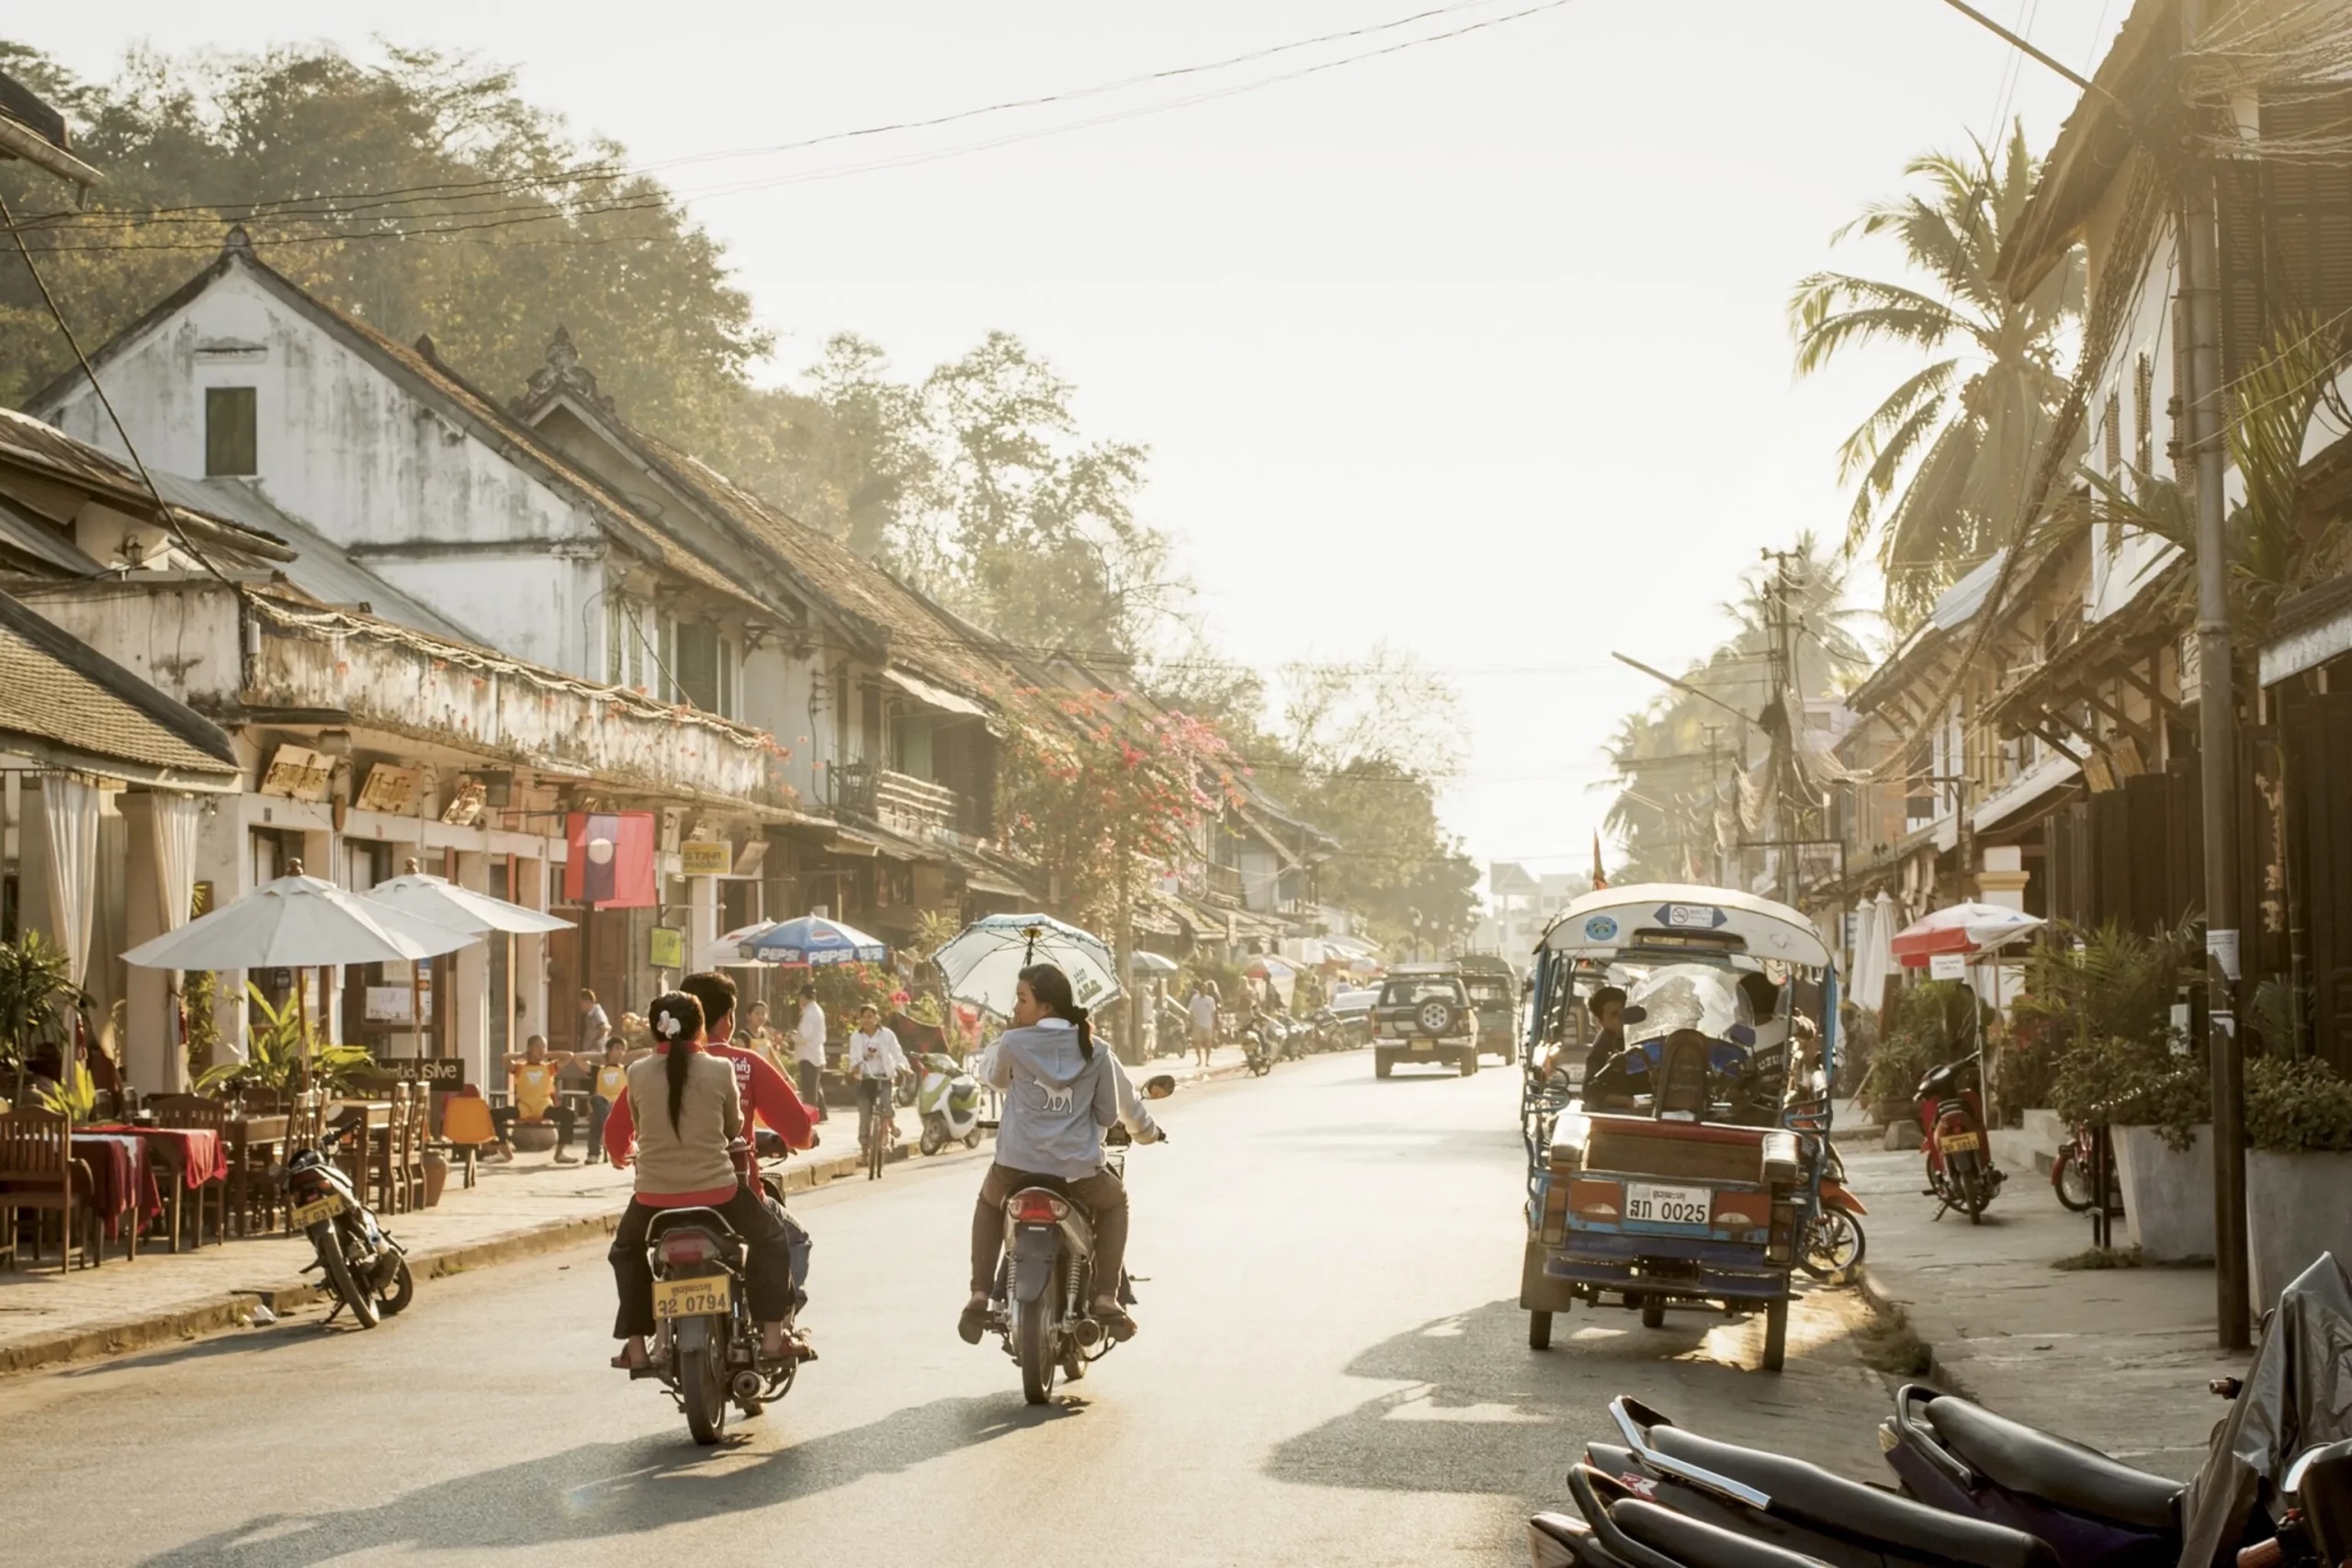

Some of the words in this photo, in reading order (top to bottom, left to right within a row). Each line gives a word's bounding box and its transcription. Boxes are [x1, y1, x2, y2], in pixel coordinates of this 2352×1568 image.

[758, 947, 799, 962] PEPSI
[808, 948, 854, 965] PEPSI
[1661, 1201, 1706, 1223] 0025
[685, 1292, 727, 1312] 0794
